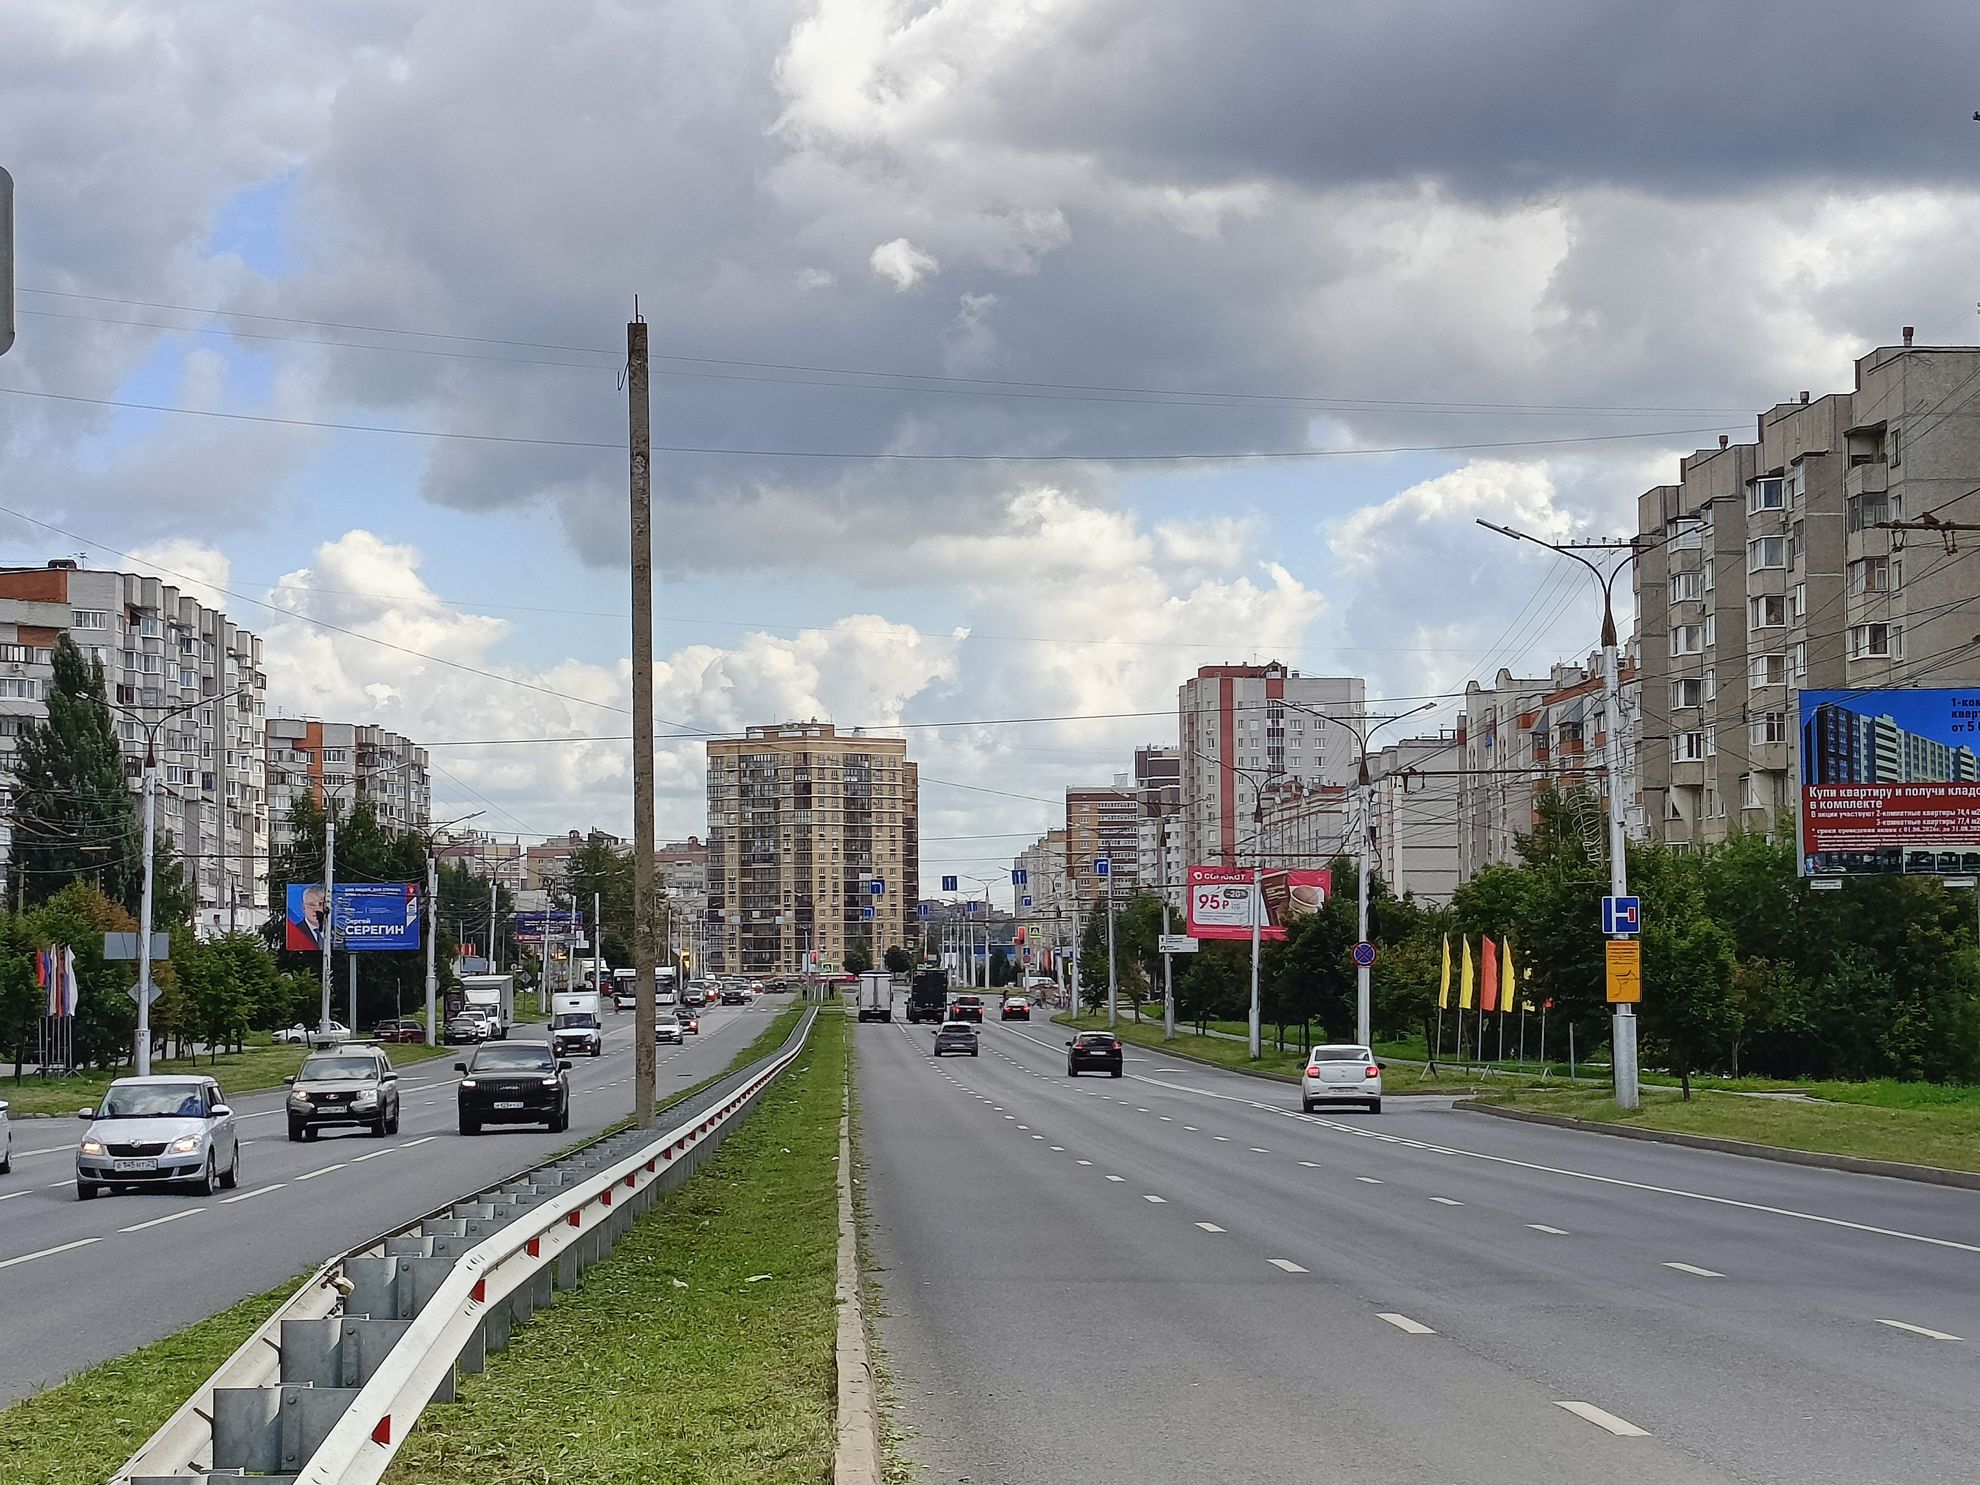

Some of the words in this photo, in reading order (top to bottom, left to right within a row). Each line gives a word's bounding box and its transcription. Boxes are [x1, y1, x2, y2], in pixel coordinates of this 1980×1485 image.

[1951, 724, 1965, 732] от
[1967, 720, 1975, 732] 5
[1809, 786, 1837, 800] Купи
[1840, 787, 1893, 800] квартиру
[1895, 788, 1902, 796] и
[1905, 787, 1945, 799] получи
[1810, 801, 1817, 809] в
[1820, 800, 1883, 809] комплекте
[1811, 810, 1816, 818] В
[1839, 811, 1875, 819] участвуют
[1876, 809, 1921, 817] 2-комнатные
[1922, 810, 1956, 818] квартиры
[1876, 818, 1921, 826] 3-комнатные
[1922, 819, 1956, 827] квартиры
[1198, 894, 1220, 910] 95
[345, 925, 404, 935] СЕРЕГИН
